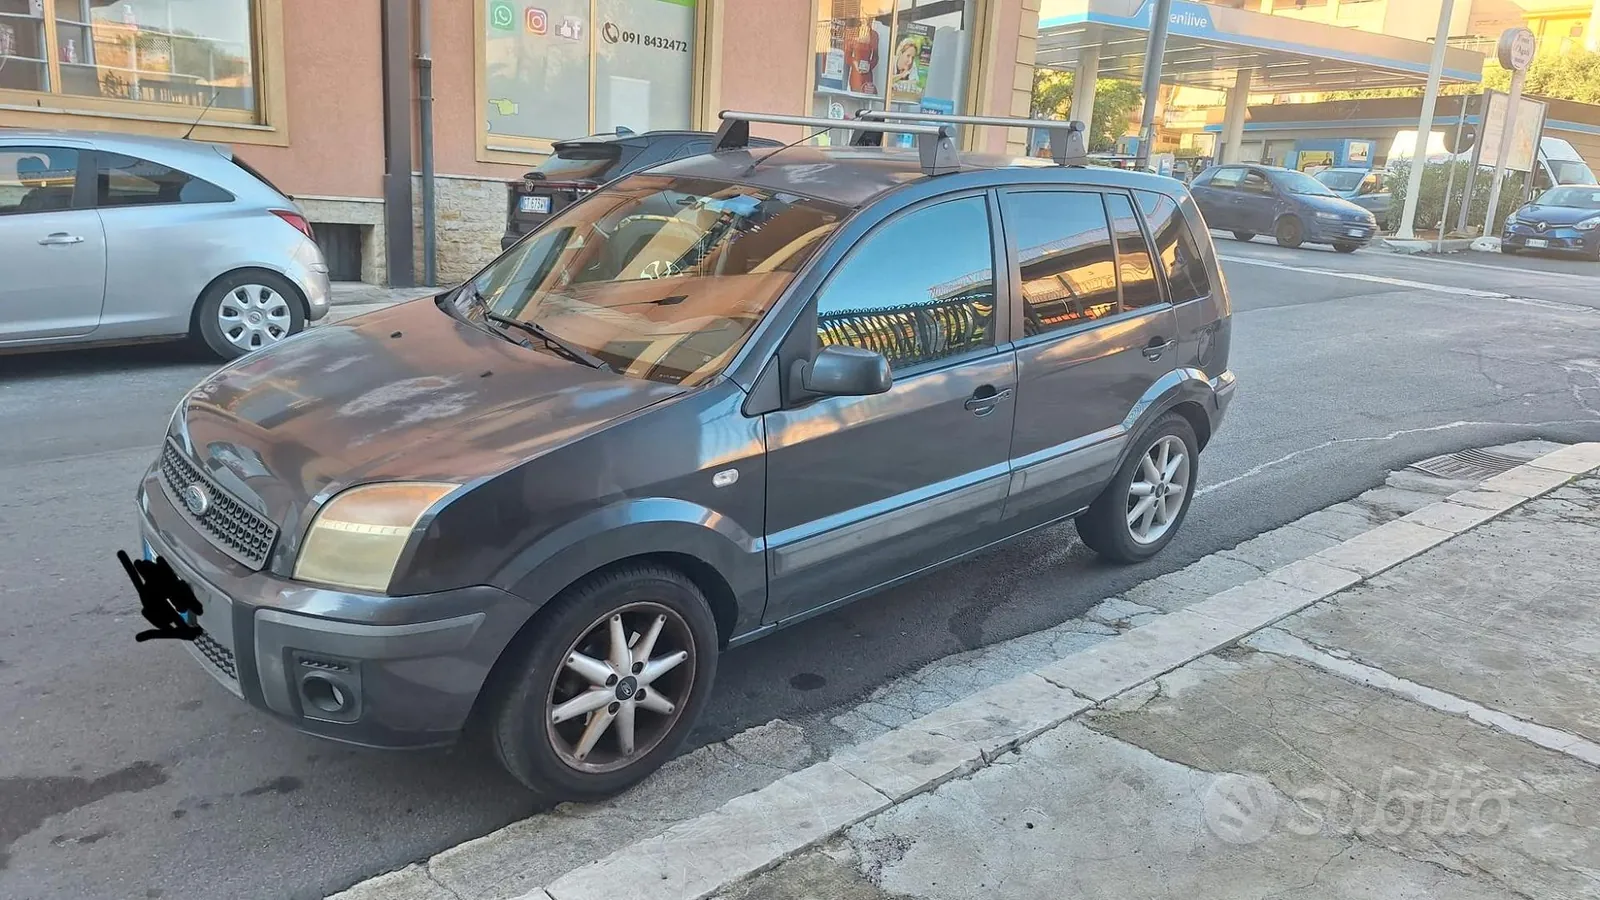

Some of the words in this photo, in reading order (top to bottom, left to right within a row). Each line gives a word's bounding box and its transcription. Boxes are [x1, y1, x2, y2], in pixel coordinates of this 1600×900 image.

[1170, 11, 1207, 28] enilive
[622, 31, 640, 45] 091
[644, 36, 687, 52] 8432472
